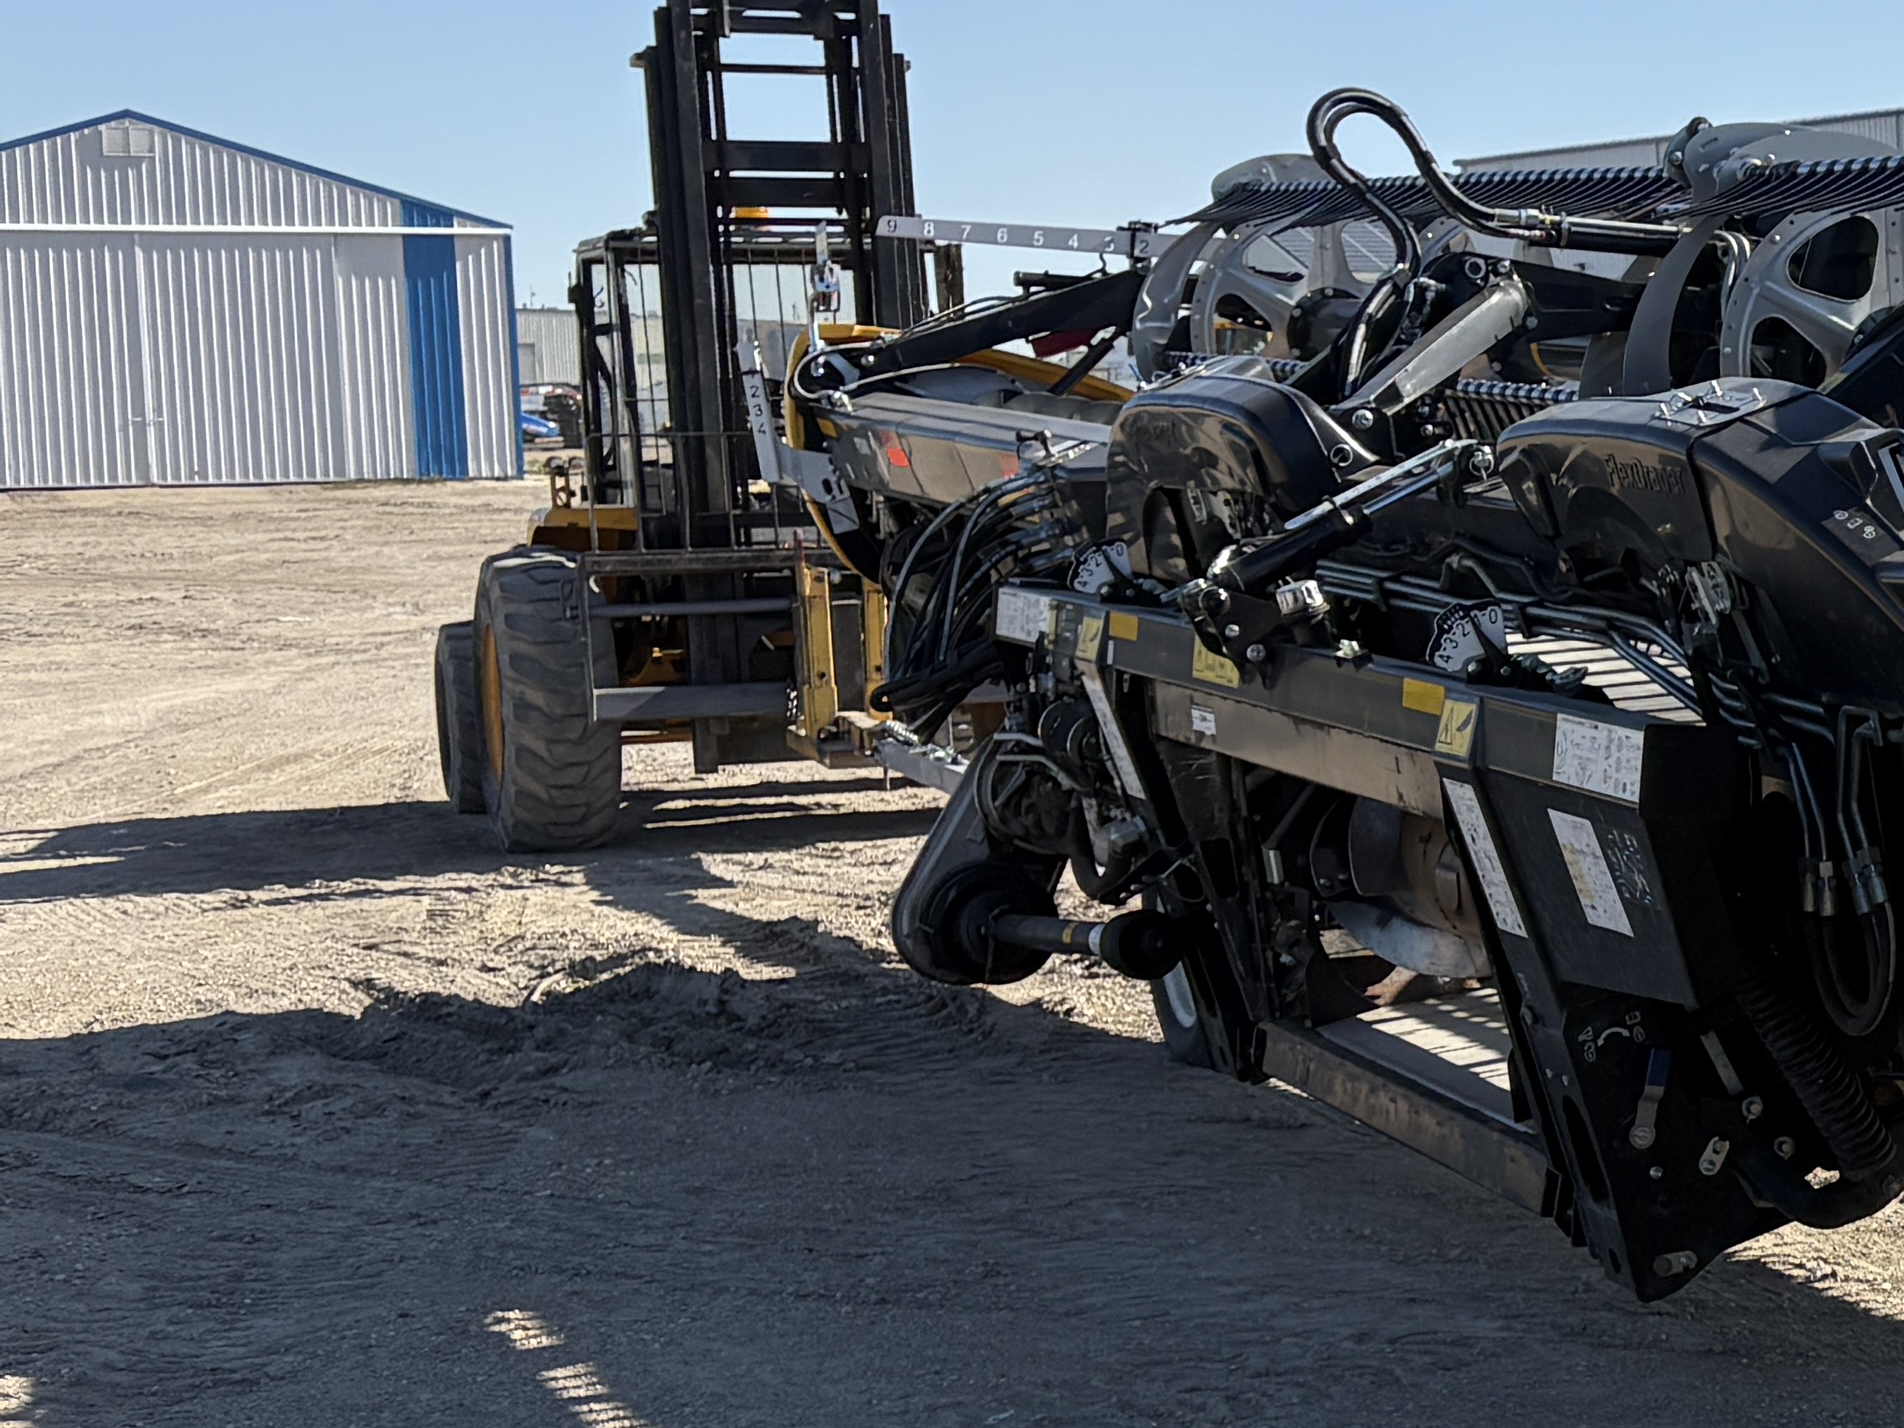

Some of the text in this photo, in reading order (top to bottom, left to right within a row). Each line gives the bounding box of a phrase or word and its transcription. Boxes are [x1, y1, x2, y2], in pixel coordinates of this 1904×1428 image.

[887, 219, 897, 233] 9
[923, 222, 934, 236] 8
[961, 225, 971, 240] 7
[997, 228, 1007, 243] 6
[1033, 231, 1044, 246] 5
[1068, 234, 1078, 249] 4
[1139, 239, 1149, 255] 2
[749, 385, 760, 398] 2
[753, 404, 763, 417] 3
